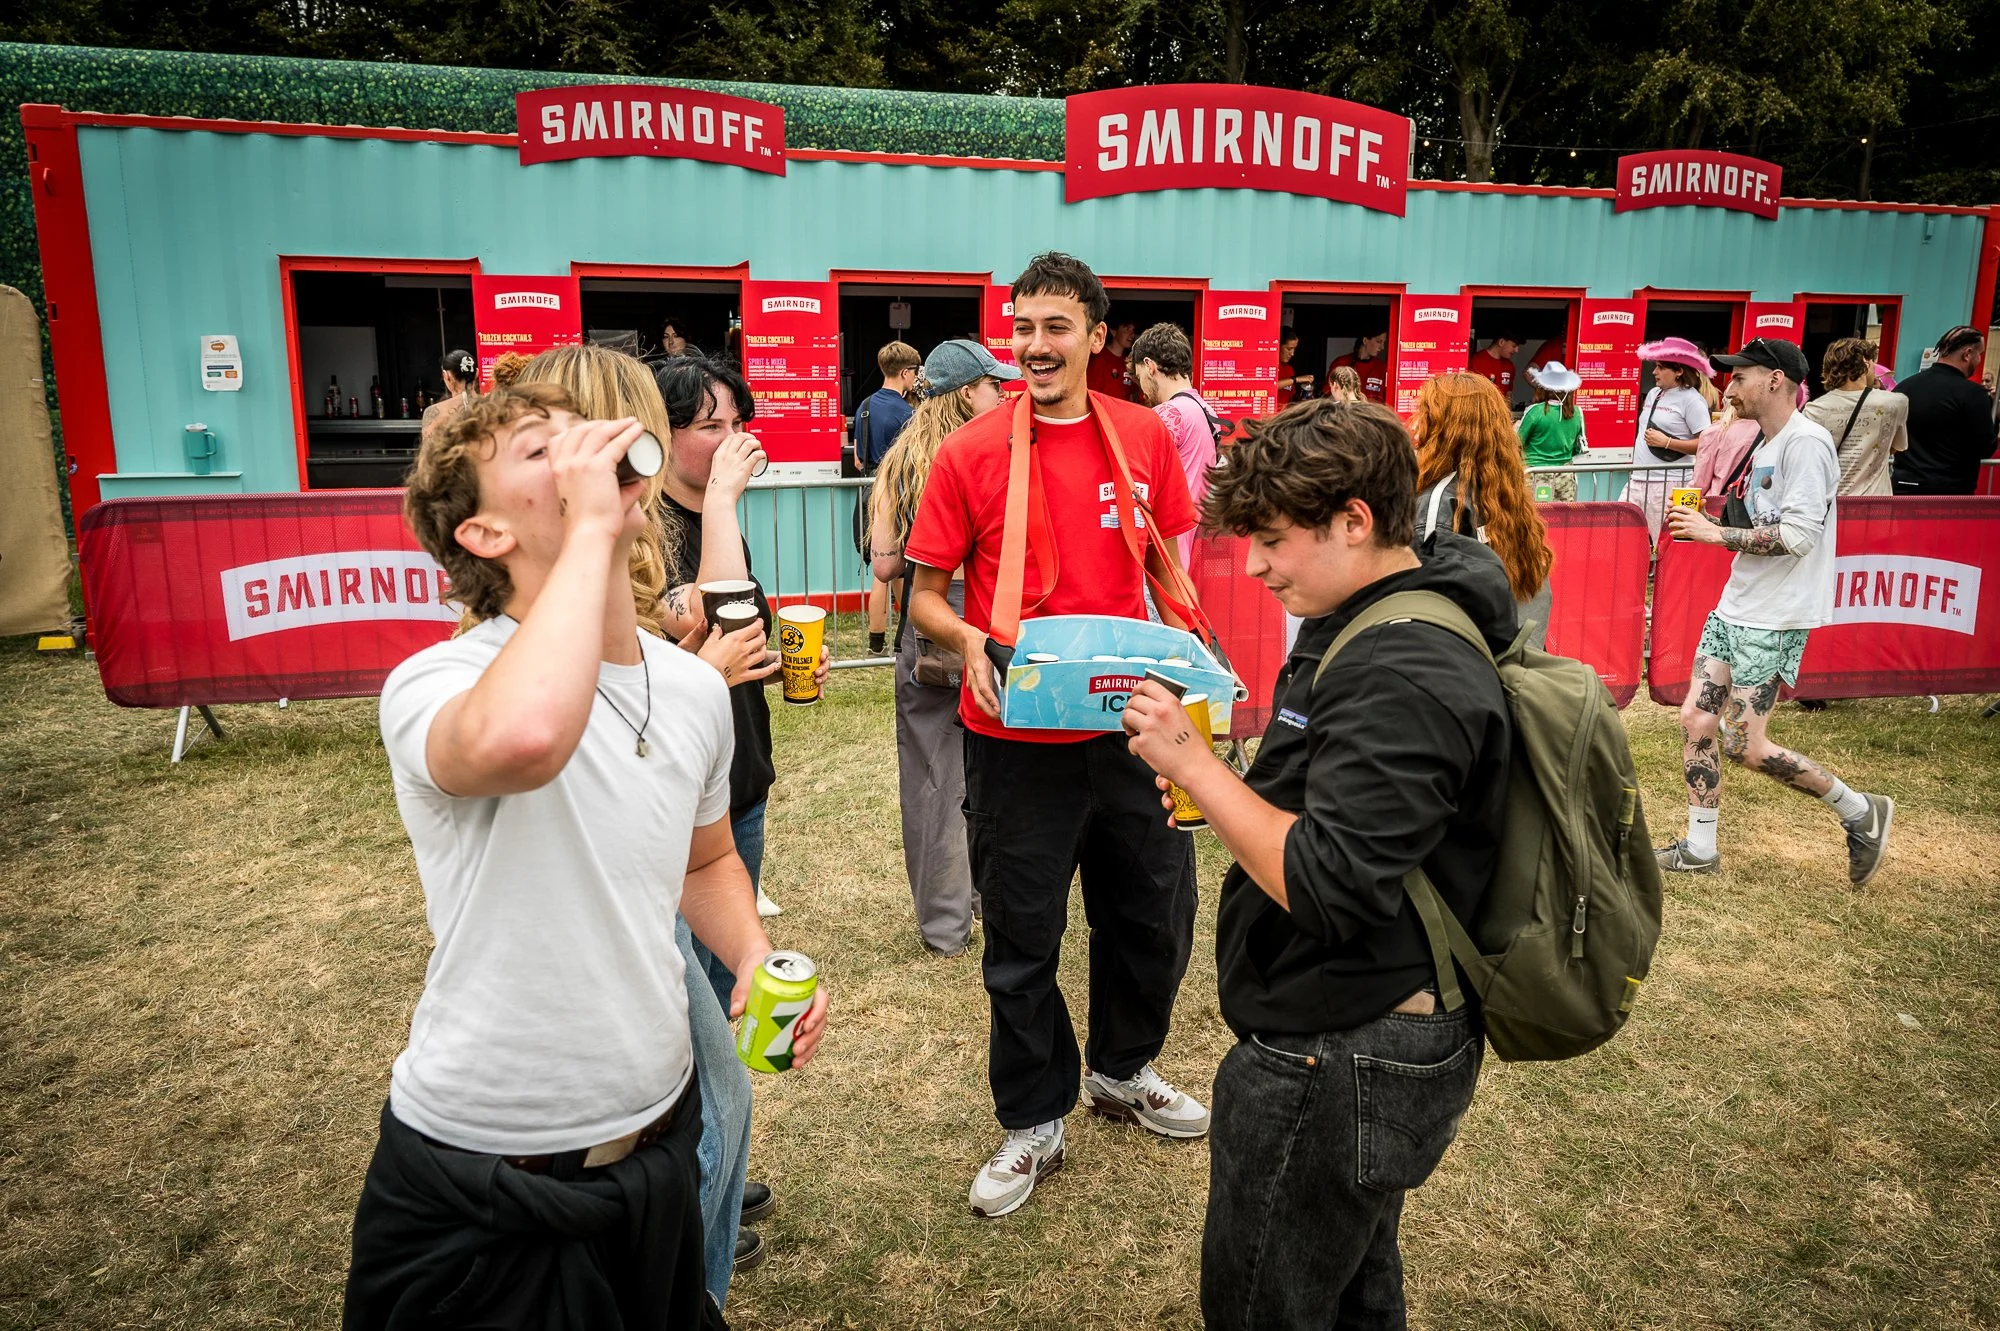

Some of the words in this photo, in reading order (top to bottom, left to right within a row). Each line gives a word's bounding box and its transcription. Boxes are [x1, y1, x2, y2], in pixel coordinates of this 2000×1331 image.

[541, 100, 763, 152] SMIRNOFF
[1098, 108, 1383, 183] SMIRNOFF
[1631, 162, 1768, 202] SMIRNOFF
[500, 295, 554, 305] SMIRNOFF
[767, 300, 815, 309] SMIRNOFF
[1223, 307, 1262, 316] SMIRNOFF
[1418, 310, 1454, 319] SMIRNOFF
[1597, 313, 1630, 322] SMIRNOFF
[1759, 317, 1790, 325] SMIRNOFF
[480, 333, 501, 342] FROZEN
[502, 334, 532, 343] COCKTAILS
[748, 335, 766, 344] FROZEN
[767, 336, 794, 344] COCKTAILS
[1836, 417, 1870, 428] 225
[244, 567, 452, 618] SMIRNOF
[1834, 571, 1959, 614] IRNOFF
[792, 656, 813, 665] PILSNER
[1095, 678, 1141, 690] SMIRNO
[1102, 694, 1131, 712] IC
